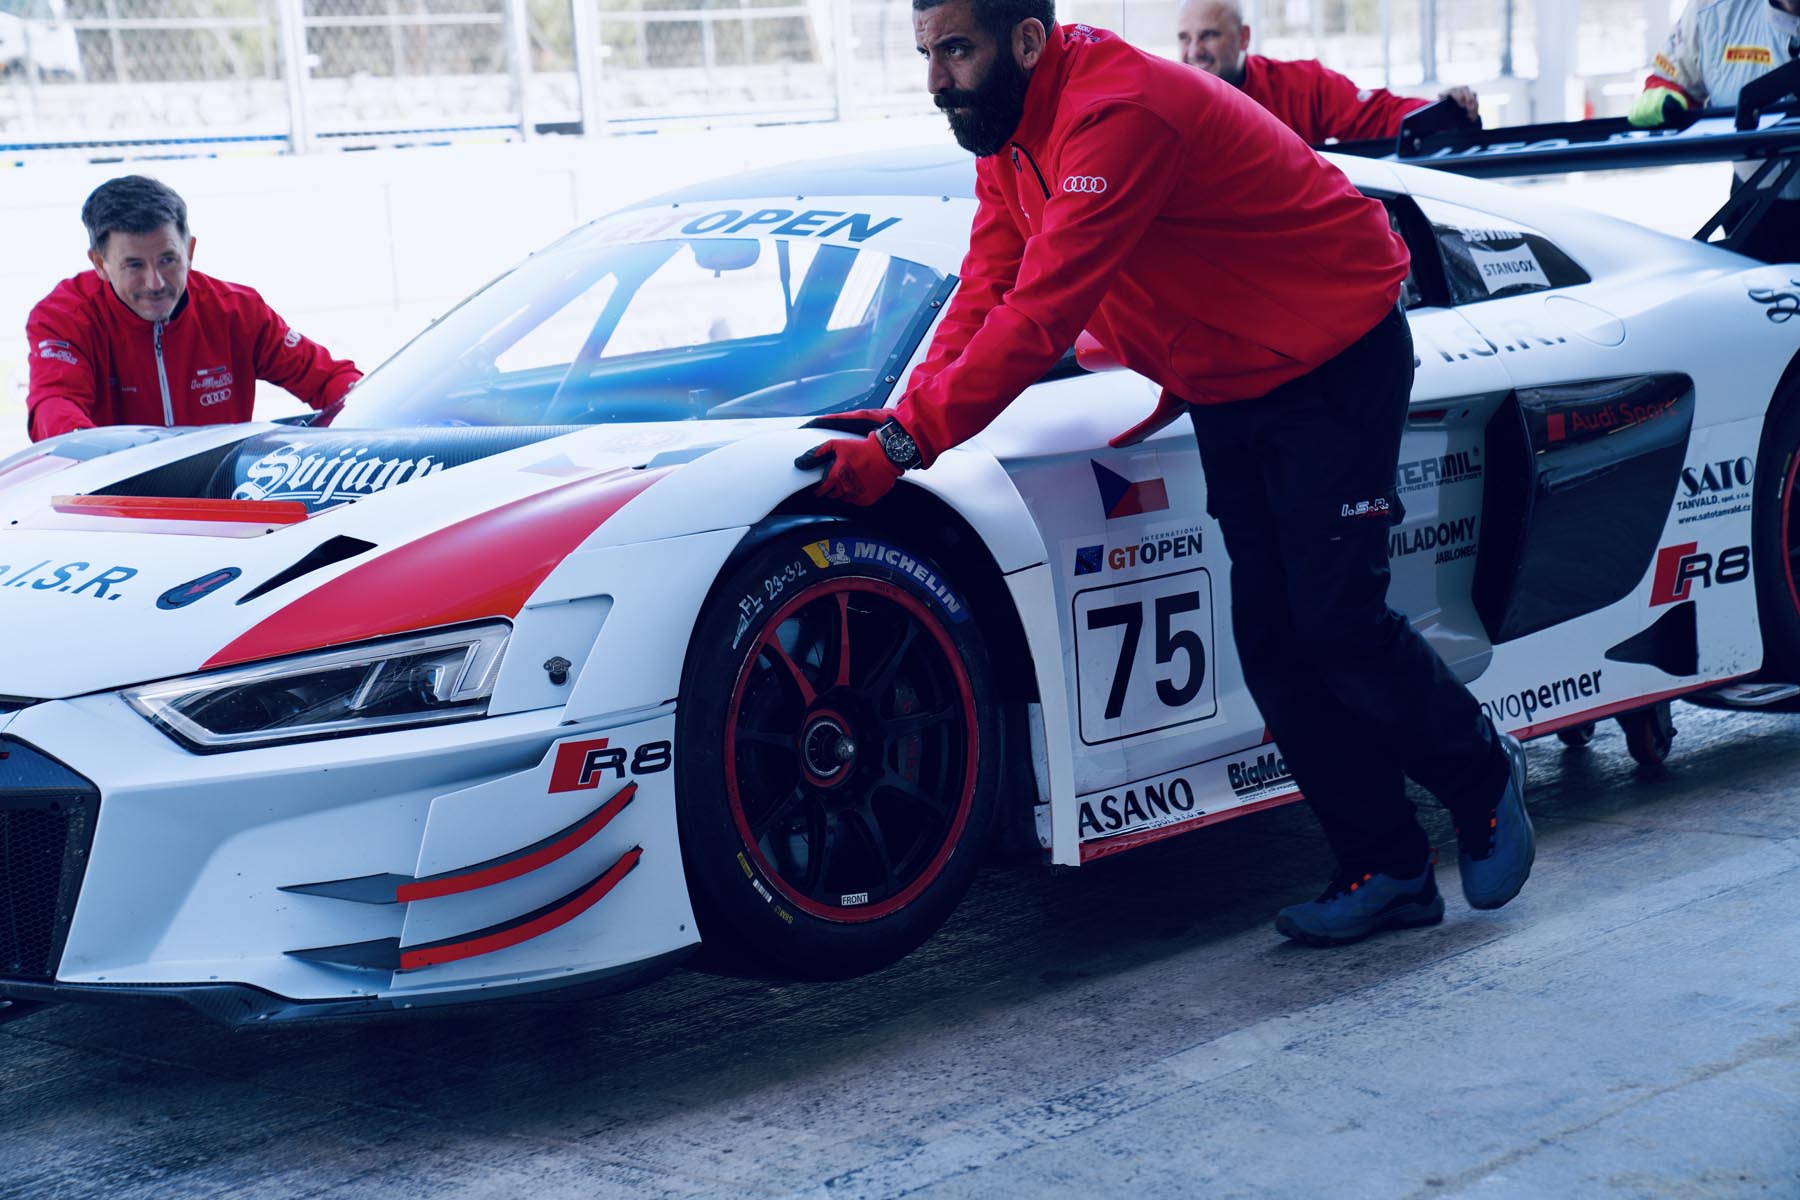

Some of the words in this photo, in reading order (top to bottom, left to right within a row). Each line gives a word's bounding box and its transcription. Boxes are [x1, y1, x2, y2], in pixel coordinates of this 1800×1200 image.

[1482, 258, 1538, 277] STANDOX
[1571, 404, 1617, 432] Audi
[1619, 398, 1678, 427] Sport
[1681, 456, 1754, 498] SATO
[1108, 533, 1203, 570] GTOPEN
[1141, 525, 1203, 543] INTERNATIONAL
[1434, 543, 1477, 565] JABLONEC
[1674, 545, 1751, 596] R8
[854, 541, 961, 614] MICHELIN
[1087, 590, 1206, 720] 75
[579, 740, 672, 784] R8
[1078, 778, 1195, 839] ASANO
[842, 893, 868, 905] FRONT
